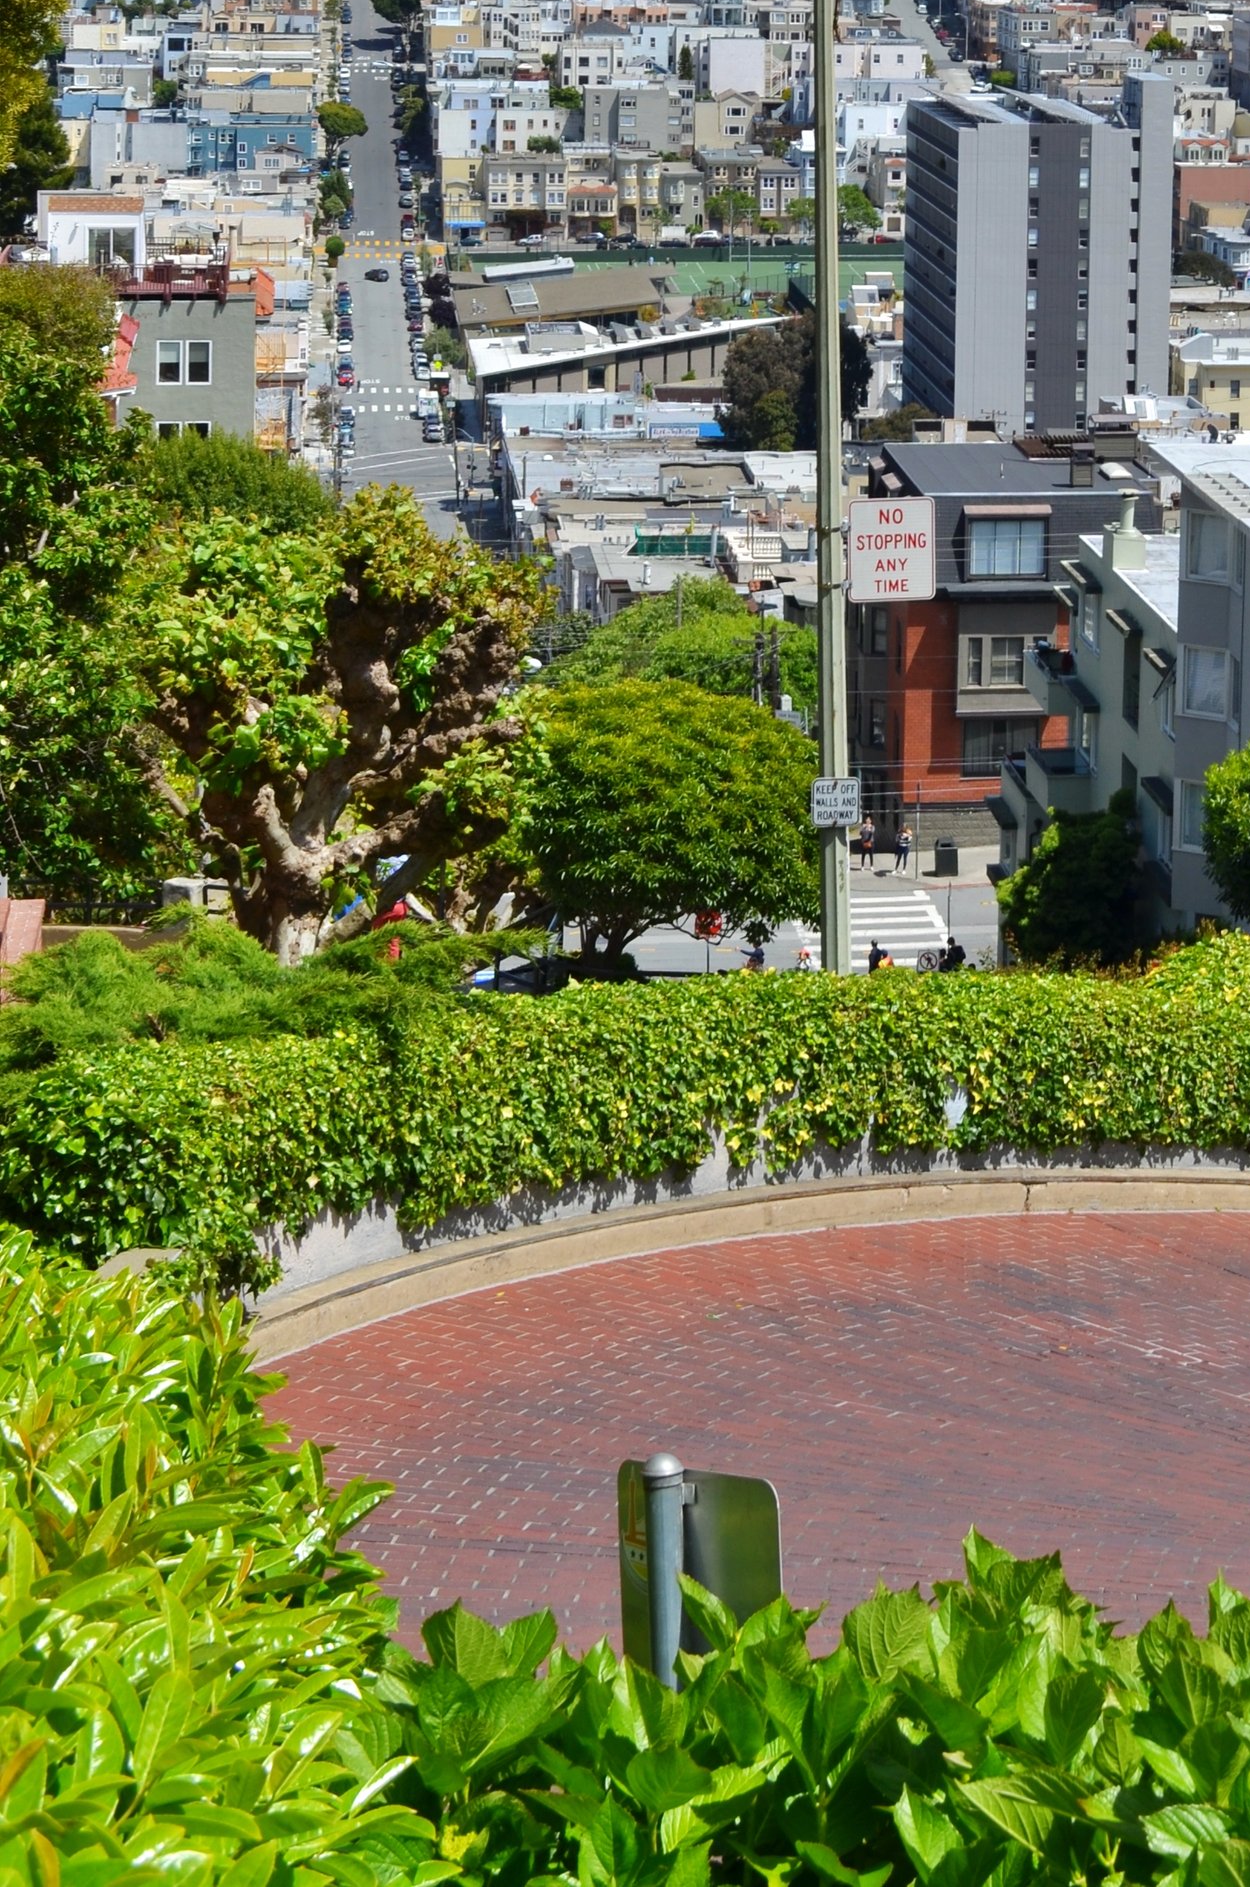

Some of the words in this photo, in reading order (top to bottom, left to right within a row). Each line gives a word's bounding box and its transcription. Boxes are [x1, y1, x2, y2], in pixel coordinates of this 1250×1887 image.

[879, 508, 904, 524] NO
[856, 533, 926, 551] STOPPING
[875, 558, 908, 572] ANY
[874, 579, 909, 593] TIME
[816, 784, 836, 794] KEEP
[840, 784, 856, 794] OFF
[816, 798, 838, 807] WALLS
[842, 797, 856, 806] AND
[817, 811, 853, 820] ROADWAY
